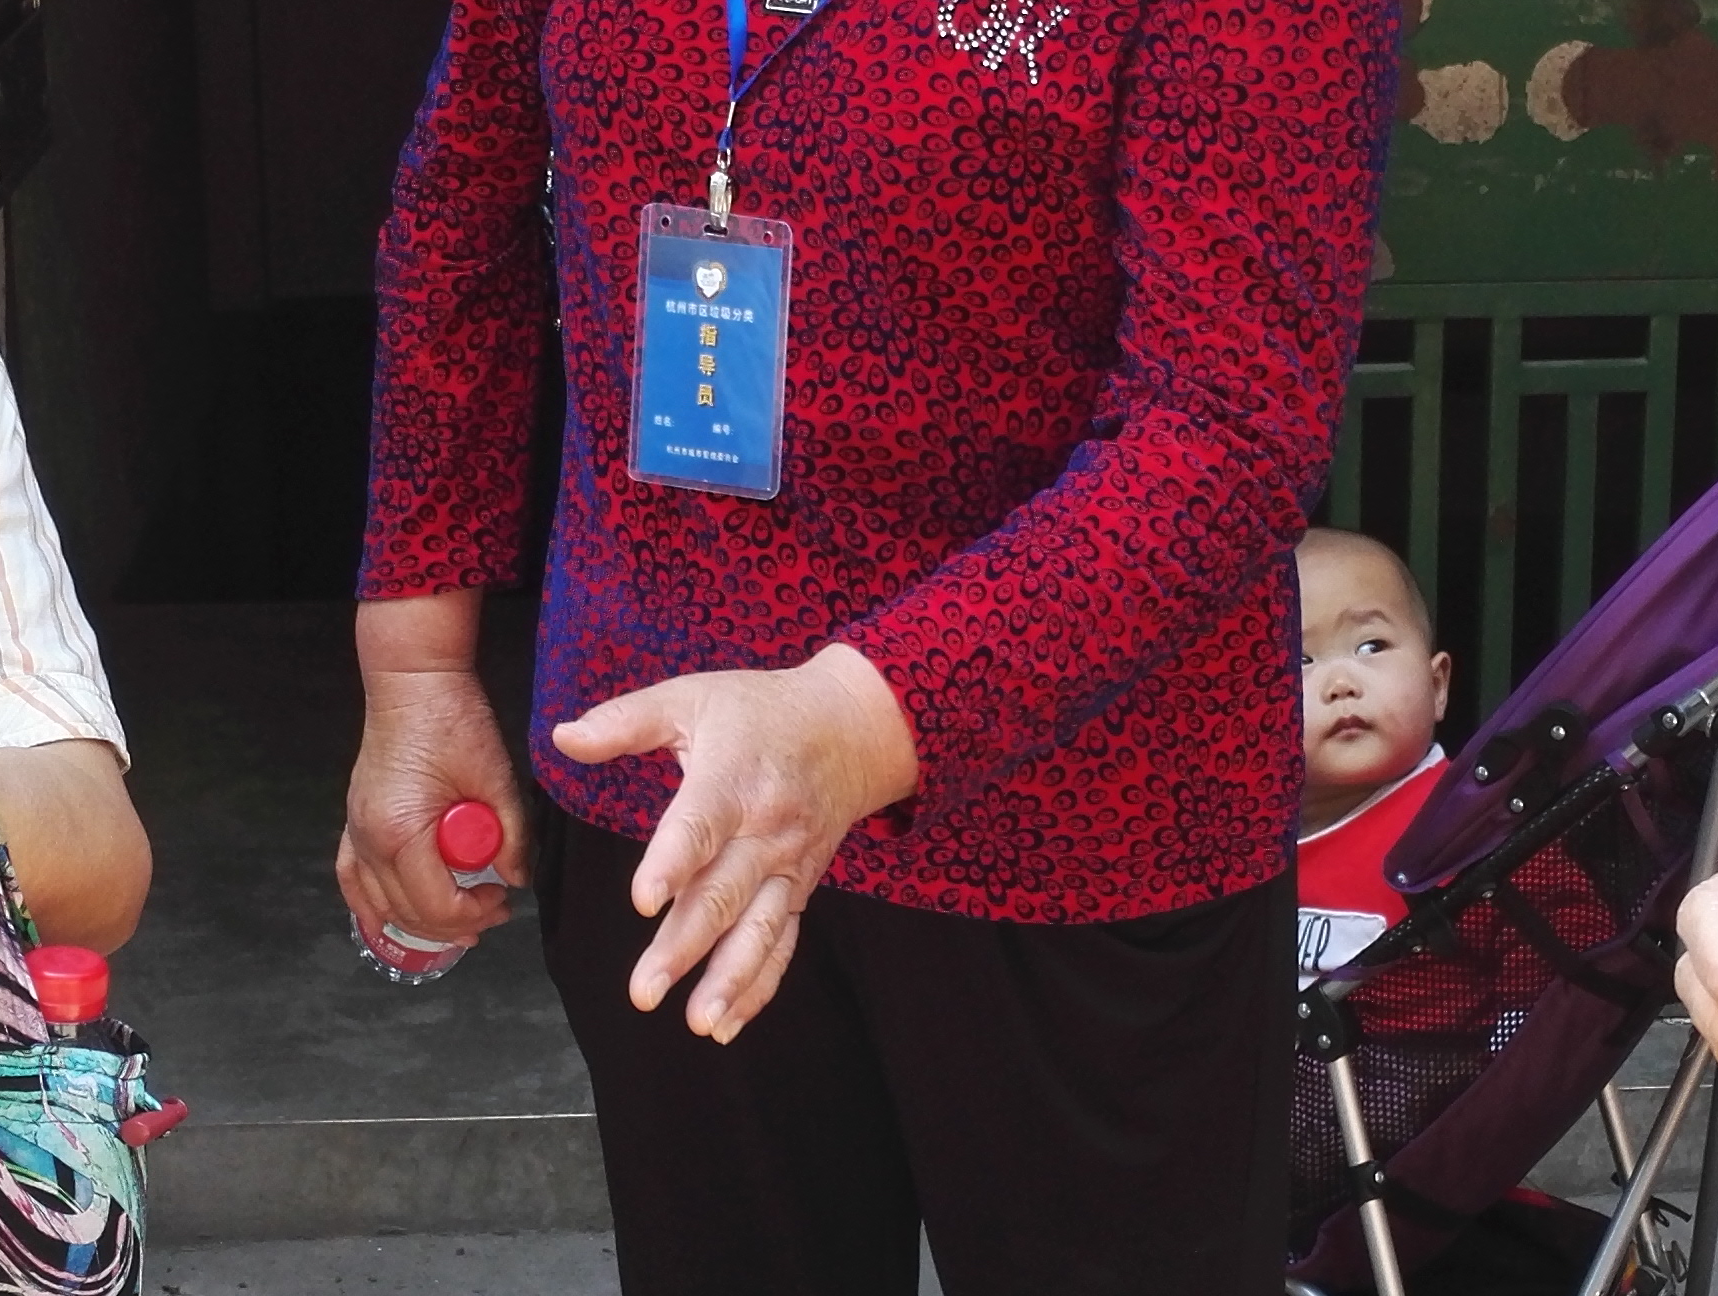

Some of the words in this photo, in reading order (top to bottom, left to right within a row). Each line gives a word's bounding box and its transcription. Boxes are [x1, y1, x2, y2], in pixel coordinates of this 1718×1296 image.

[665, 300, 754, 323] 杭州市区垃圾分类
[697, 323, 717, 407] 指导员
